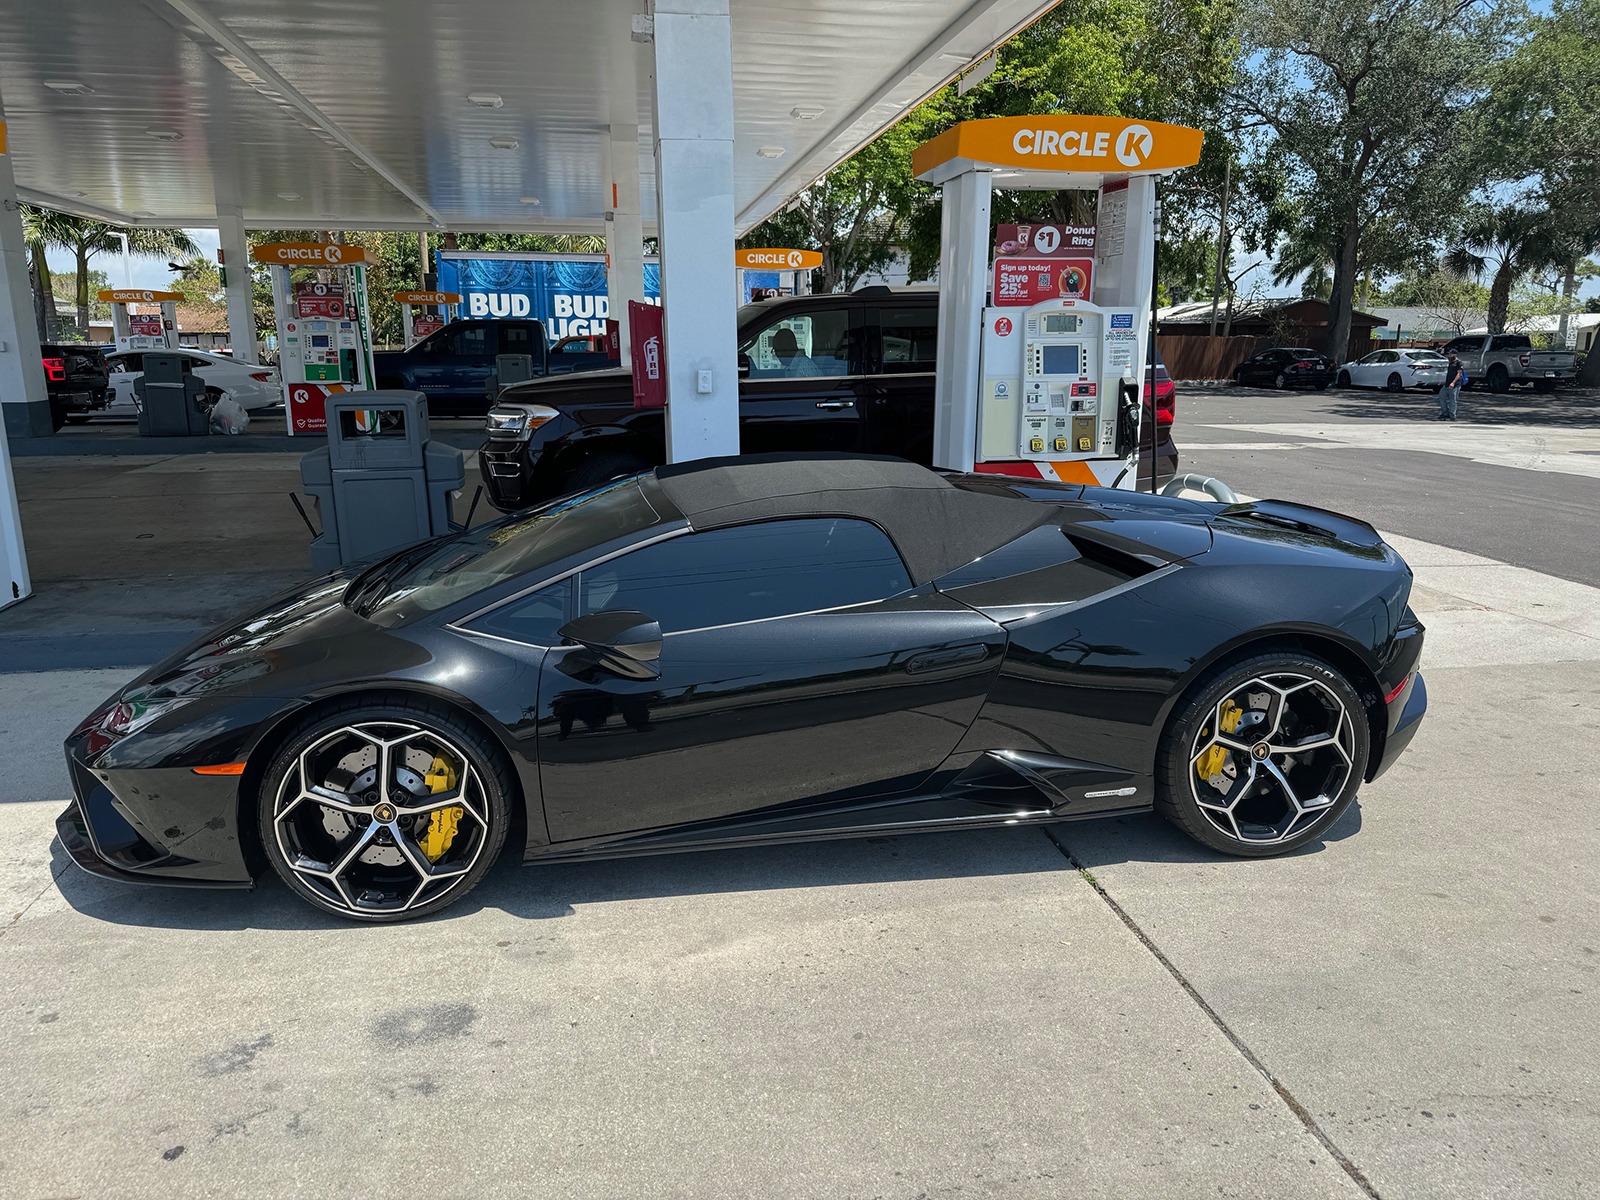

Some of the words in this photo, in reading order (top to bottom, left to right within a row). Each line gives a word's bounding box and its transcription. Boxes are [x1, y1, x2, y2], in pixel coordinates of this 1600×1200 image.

[1012, 129, 1110, 157] CIRCLE
[1115, 124, 1153, 167] K
[1065, 225, 1096, 235] Donut
[1038, 231, 1055, 248] $1
[1071, 236, 1095, 247] Ring
[277, 248, 322, 260] CIRCLE
[324, 245, 342, 263] K
[747, 253, 785, 264] CIRCLE
[787, 251, 803, 267] K
[1000, 264, 1017, 272] Sign
[1028, 264, 1051, 272] today!
[1000, 272, 1029, 283] Save
[113, 292, 142, 300] CIRCLE
[142, 290, 155, 302] K
[407, 294, 434, 302] CIRCLE
[435, 293, 446, 303] K
[469, 293, 531, 317] BUD
[554, 294, 610, 319] BUD
[357, 282, 368, 352] DIESEL
[548, 317, 607, 341] LIGH
[648, 347, 658, 376] FIRE
[294, 389, 309, 404] K
